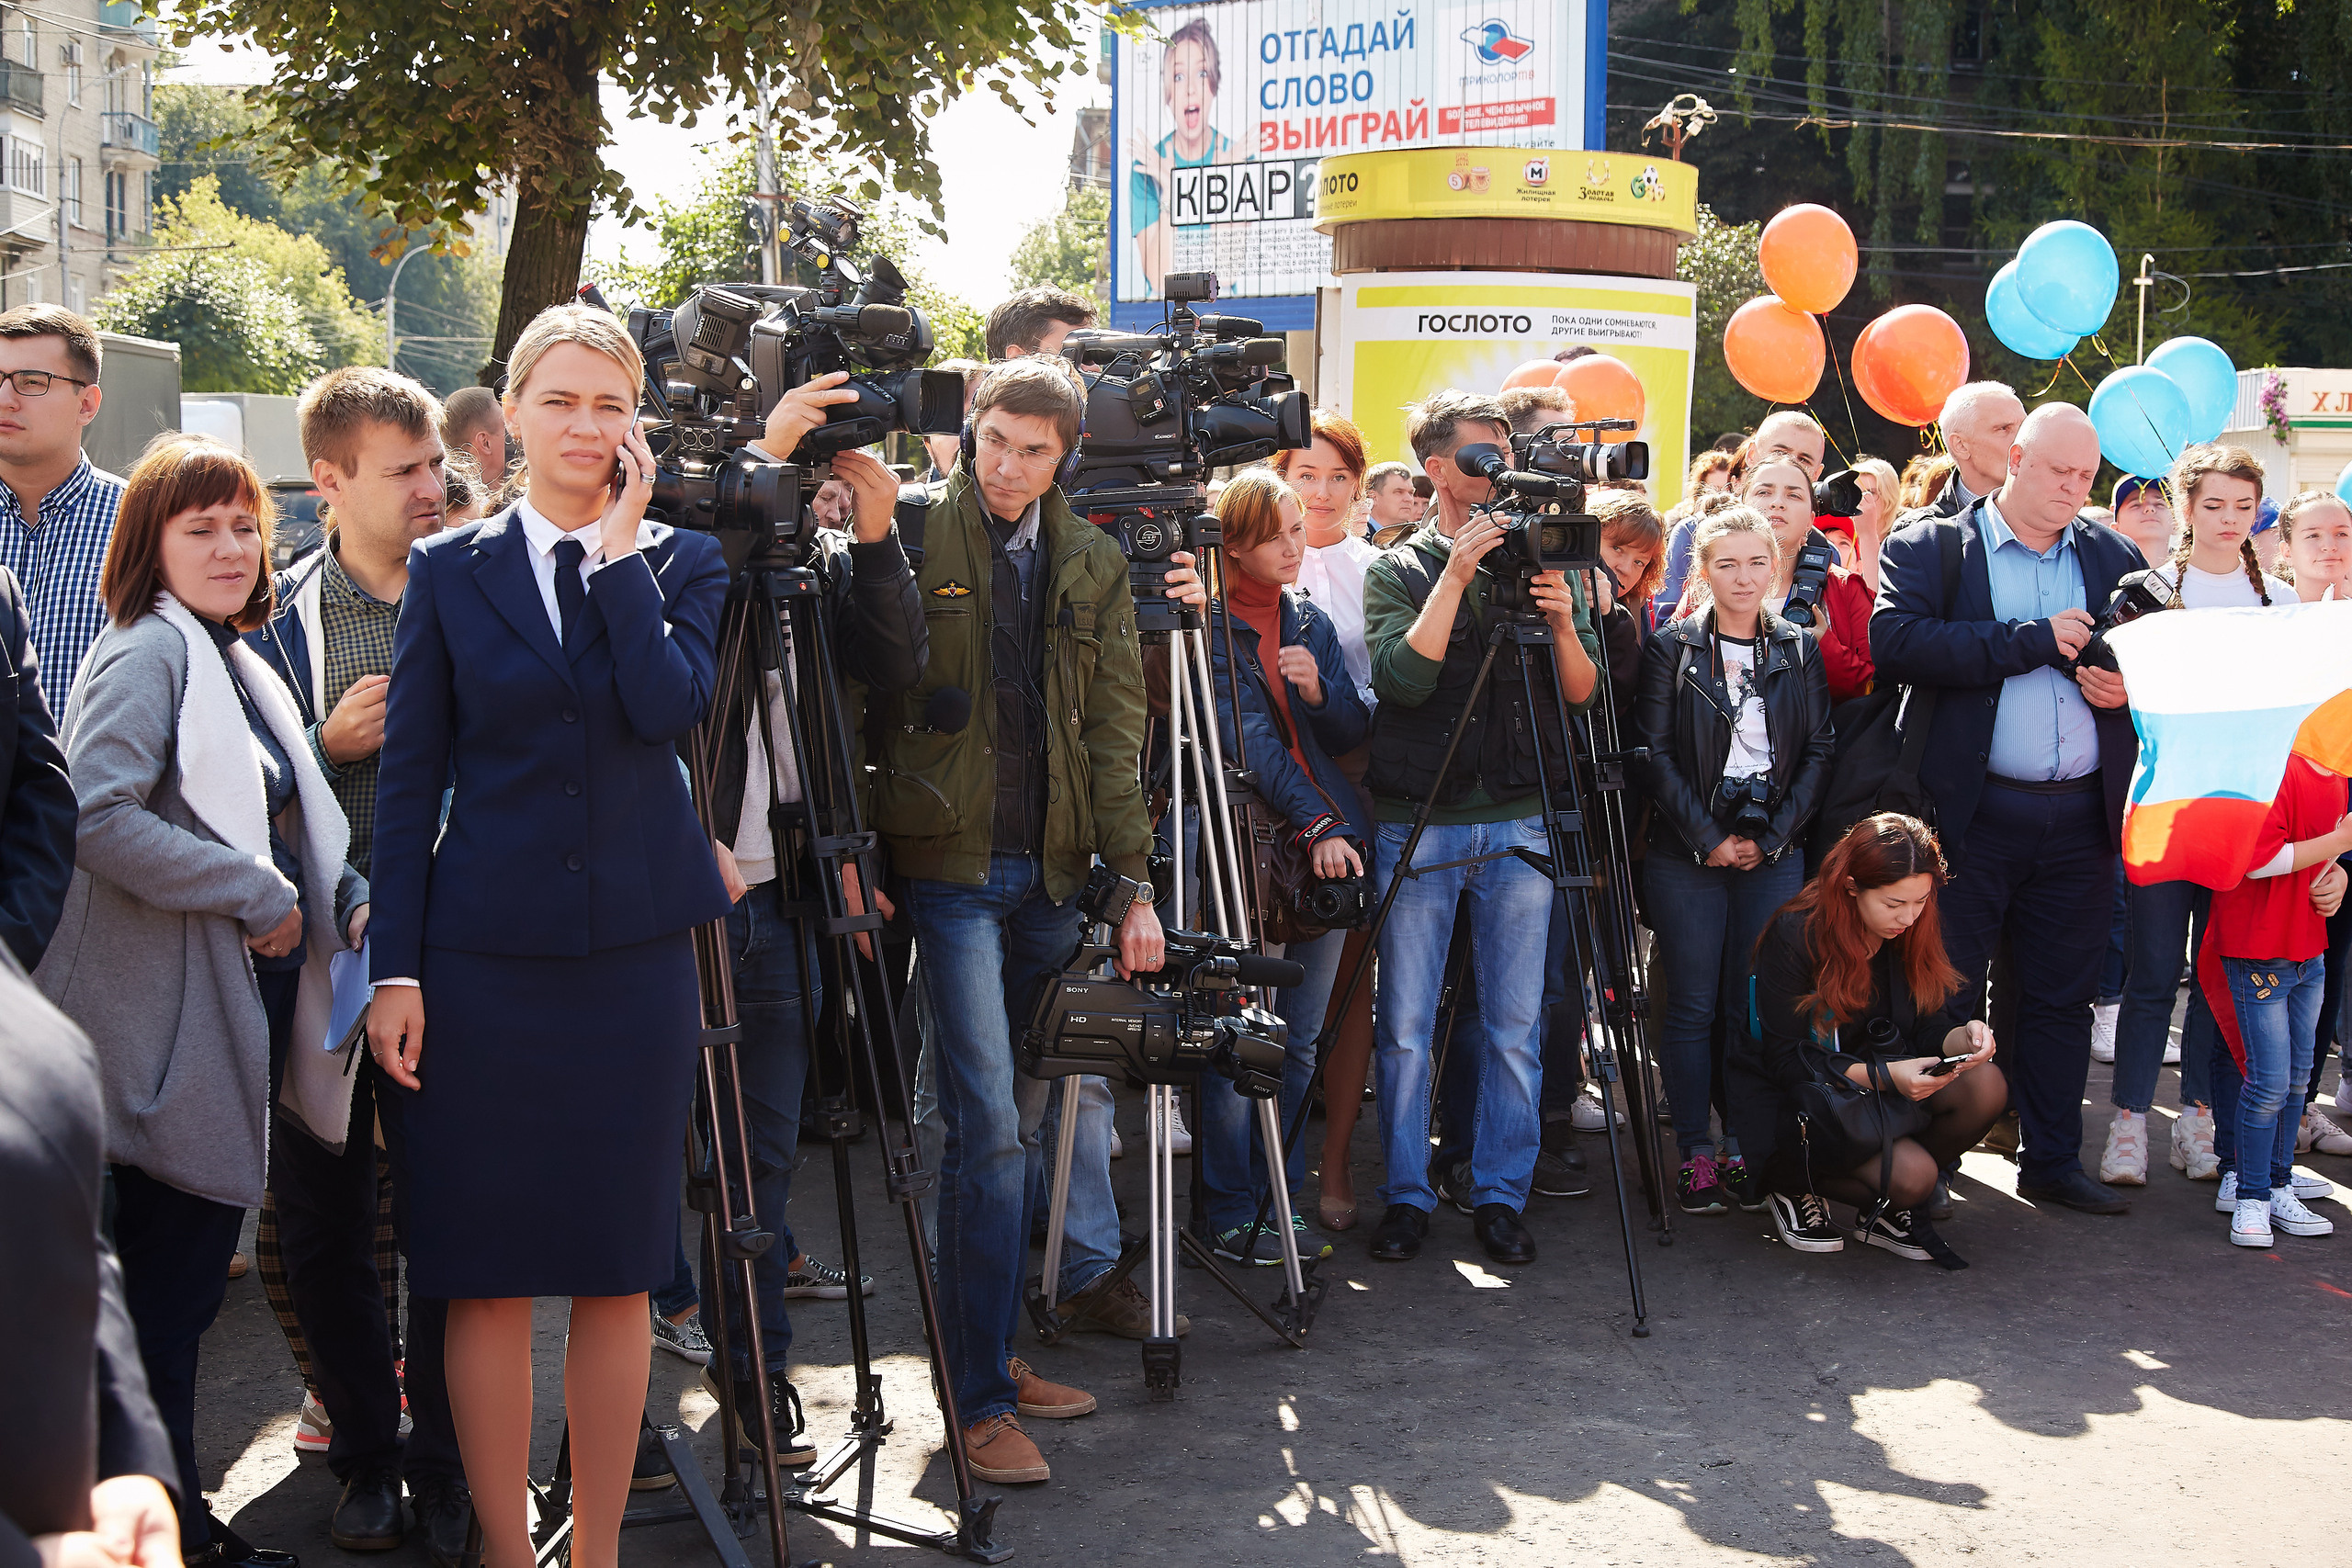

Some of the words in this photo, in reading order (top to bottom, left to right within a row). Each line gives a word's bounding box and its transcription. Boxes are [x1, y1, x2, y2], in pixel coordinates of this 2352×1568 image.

[1261, 9, 1415, 64] ОТГАДАЙ
[1260, 70, 1374, 110] СЛОВО
[1486, 105, 1504, 117] ЧЕМ
[1260, 98, 1430, 152] ВЫИГРАЙ
[1516, 187, 1556, 197] Жилищная
[1521, 195, 1551, 203] лотерея
[695, 315, 706, 338] SONY
[1418, 314, 1532, 333] ГОСЛОТО
[1552, 315, 1577, 326] ПОКА
[1578, 316, 1602, 327] ОДНИ
[1604, 317, 1657, 331] СОМНЕВАЮТСЯ,
[1551, 327, 1586, 336] ДРУГИЕ
[1588, 328, 1643, 340] ВЫИГРЫВАЮТ!
[1756, 636, 1764, 665] SONY
[1304, 816, 1333, 839] Canon
[1252, 1084, 1272, 1094] SONY
